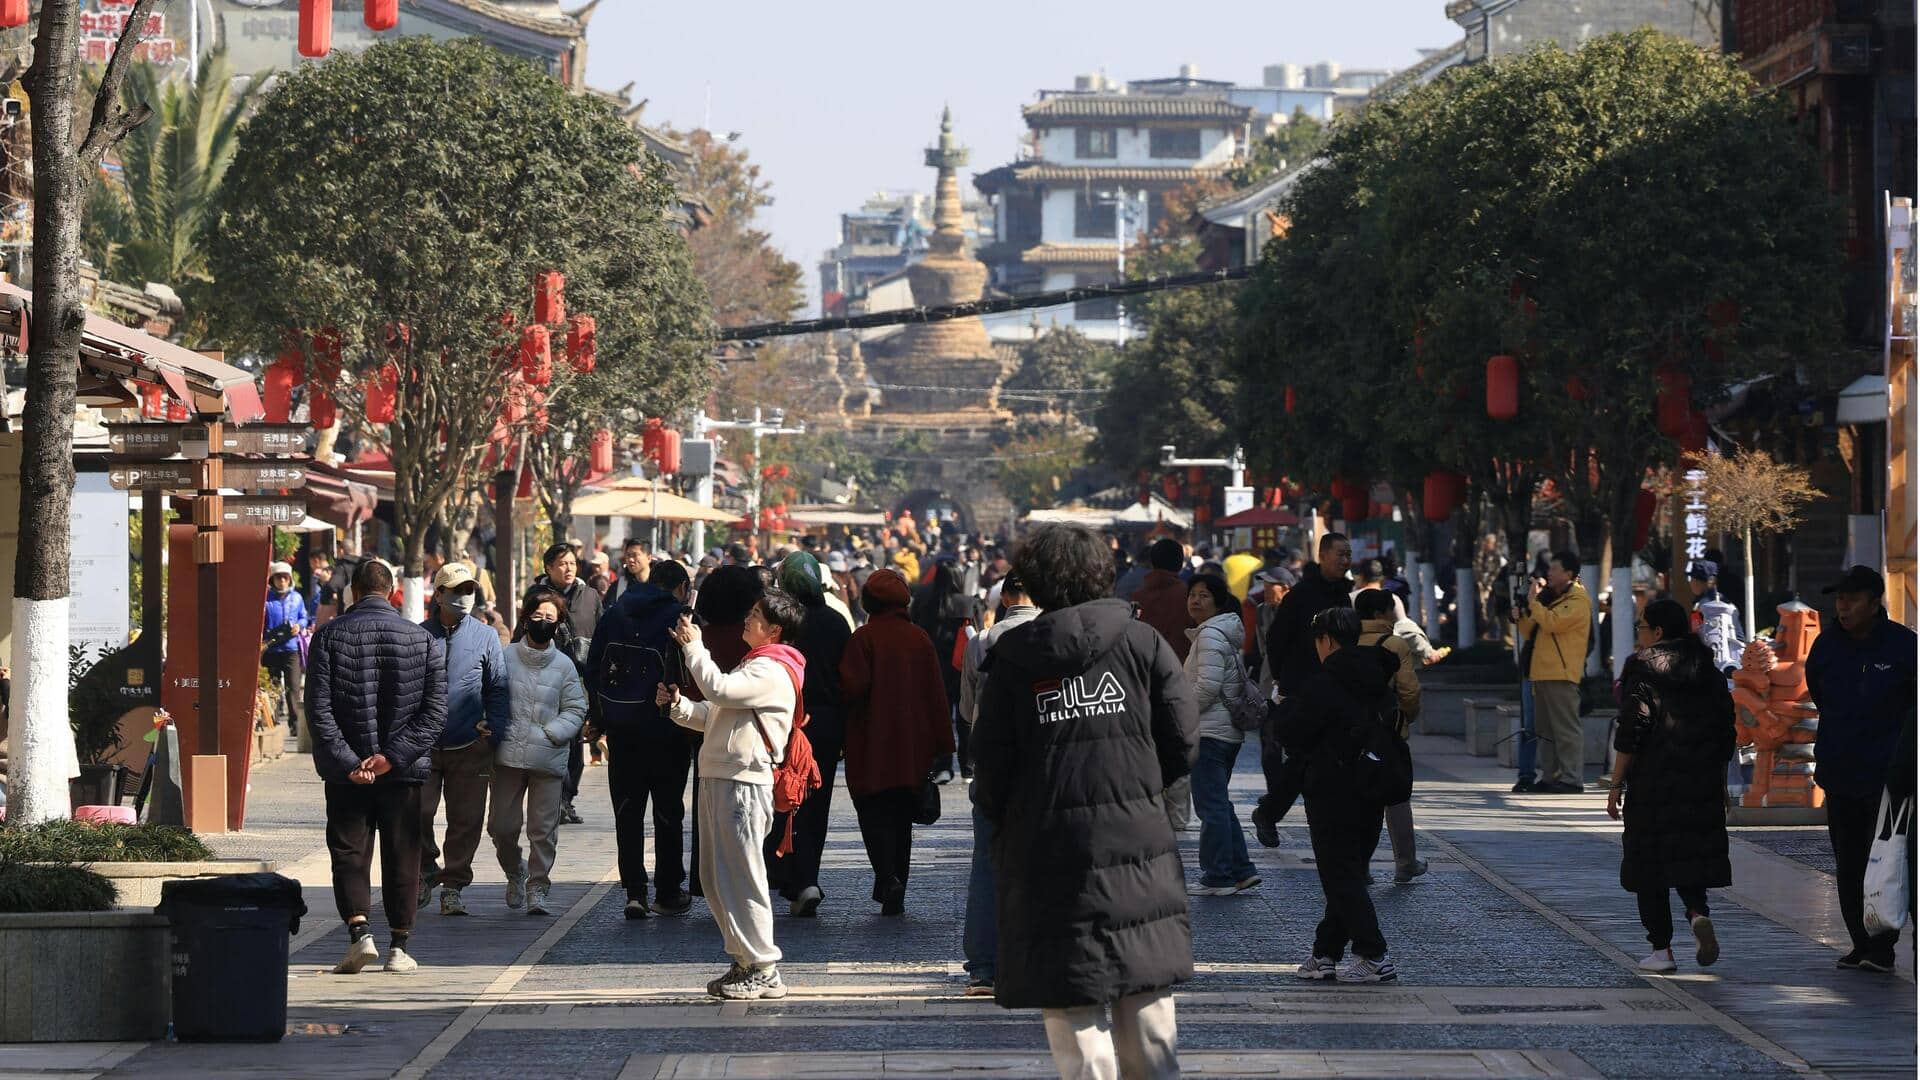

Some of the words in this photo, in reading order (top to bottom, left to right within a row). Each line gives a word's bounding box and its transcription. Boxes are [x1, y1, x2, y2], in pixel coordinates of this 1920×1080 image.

[245, 507, 271, 516] 卫生间
[1033, 671, 1126, 713] FILA
[1039, 709, 1080, 724] BIELLA
[1085, 702, 1126, 717] ITALIA
